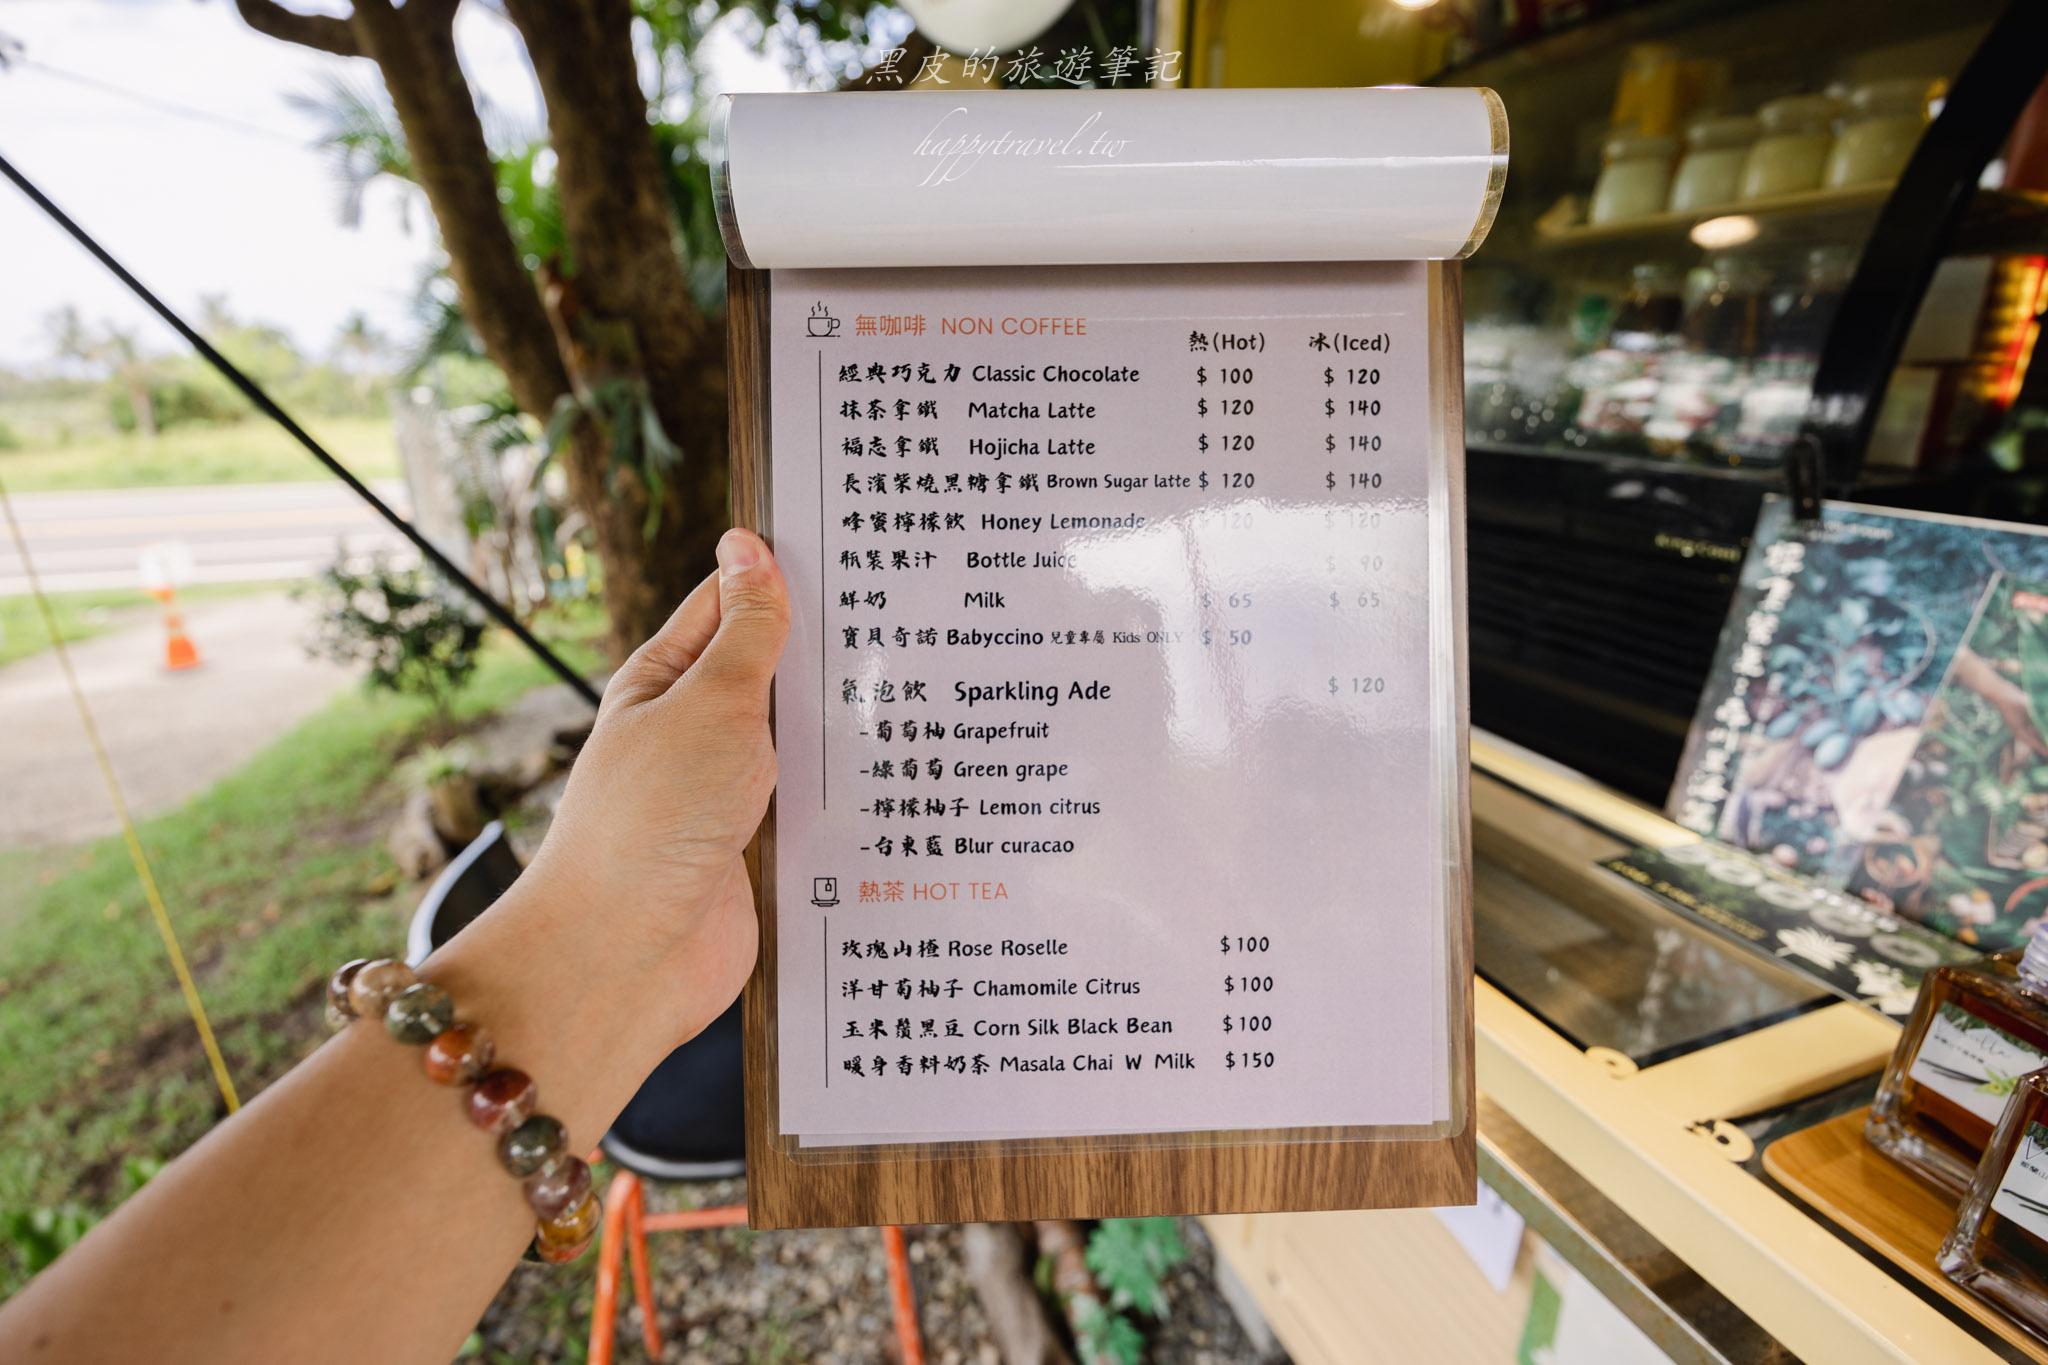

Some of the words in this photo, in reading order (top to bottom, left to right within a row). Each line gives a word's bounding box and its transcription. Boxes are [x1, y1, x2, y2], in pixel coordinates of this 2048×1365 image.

[855, 313, 927, 337] 無咖啡
[941, 316, 993, 336] NON
[1001, 317, 1087, 336] COFFEE
[1188, 330, 1265, 353] 熱(Hot)
[1308, 332, 1391, 354] 冰(Iced)
[838, 361, 962, 385] 經典巧克力
[972, 364, 1036, 383] Classic
[1042, 365, 1140, 383] Chocolate
[1196, 365, 1208, 387] $
[1220, 367, 1254, 385] 100
[1323, 366, 1335, 388] $
[1347, 368, 1381, 385] 120
[839, 398, 938, 422] 抹茶拿鐵
[968, 401, 1041, 420] Matcha
[1047, 401, 1097, 419] Latte
[1197, 397, 1208, 419] $
[1221, 399, 1254, 416] 120
[1324, 397, 1336, 419] $
[1348, 399, 1381, 417] 140
[841, 435, 940, 459] 福志拿鐵
[969, 437, 1041, 461] Hojicha
[1047, 438, 1096, 456] Latte
[1198, 432, 1209, 454] $
[1222, 434, 1255, 452] 120
[1325, 433, 1336, 454] $
[1349, 435, 1382, 452] 140
[842, 471, 1040, 495] 長濱柴燒黑糖拿鐵
[1046, 473, 1098, 489] Brown
[1103, 473, 1149, 493] Sugar
[1154, 473, 1191, 489] latte
[1198, 470, 1209, 492] $
[1222, 472, 1255, 489] 120
[1325, 471, 1336, 492] $
[1349, 472, 1382, 489] 140
[841, 510, 966, 534] 蜂蜜檸檬飲
[981, 513, 1043, 534] Honey
[1049, 512, 1146, 531] Lemonade
[839, 549, 938, 572] 瓶裝果汁
[966, 551, 1027, 569] Bottle
[1033, 550, 1077, 570] Juice
[1360, 554, 1384, 572] 90
[839, 590, 887, 611] 鮮奶
[964, 591, 1006, 609] Milk
[1228, 592, 1253, 609] 65
[1357, 592, 1381, 609] 65
[841, 625, 939, 650] 寶貝奇諾
[946, 627, 1044, 649] Babyccino
[1050, 630, 1105, 645] 兒童專屬
[1112, 631, 1141, 645] Kids
[1146, 630, 1184, 645] ONLY
[1228, 630, 1253, 646] 50
[841, 678, 928, 705] 氣泡飲
[954, 680, 1059, 708] Sparkling
[1067, 679, 1112, 701] Ade
[1351, 676, 1385, 692] 120
[953, 720, 1050, 745] Grapefruit
[953, 760, 1009, 778] Green
[1015, 763, 1068, 783] grape
[979, 799, 1042, 816] Lemon
[1049, 797, 1101, 815] citrus
[954, 837, 995, 855] Blur
[1000, 840, 1075, 854] curacao
[857, 879, 906, 903] 熱茶
[912, 882, 962, 901] HOT
[967, 882, 1009, 901] TEA
[841, 938, 940, 960] 玫瑰山楂
[948, 940, 993, 958] Rose
[1001, 938, 1068, 957] Roselle
[841, 977, 964, 1001] 洋甘菊柚子
[973, 978, 1078, 997] Chamomile
[1085, 977, 1141, 995] Citrus
[842, 1017, 965, 1040] 玉米鬚黑豆
[973, 1019, 1021, 1037] Corn
[1027, 1018, 1060, 1036] Silk
[1067, 1017, 1119, 1035] Black
[1126, 1017, 1173, 1034] Bean
[843, 1053, 991, 1078] 暖身香料奶茶
[1000, 1055, 1066, 1073] Masala
[1072, 1053, 1113, 1072] Chai
[1125, 1053, 1142, 1071] W
[1154, 1052, 1196, 1070] Milk
